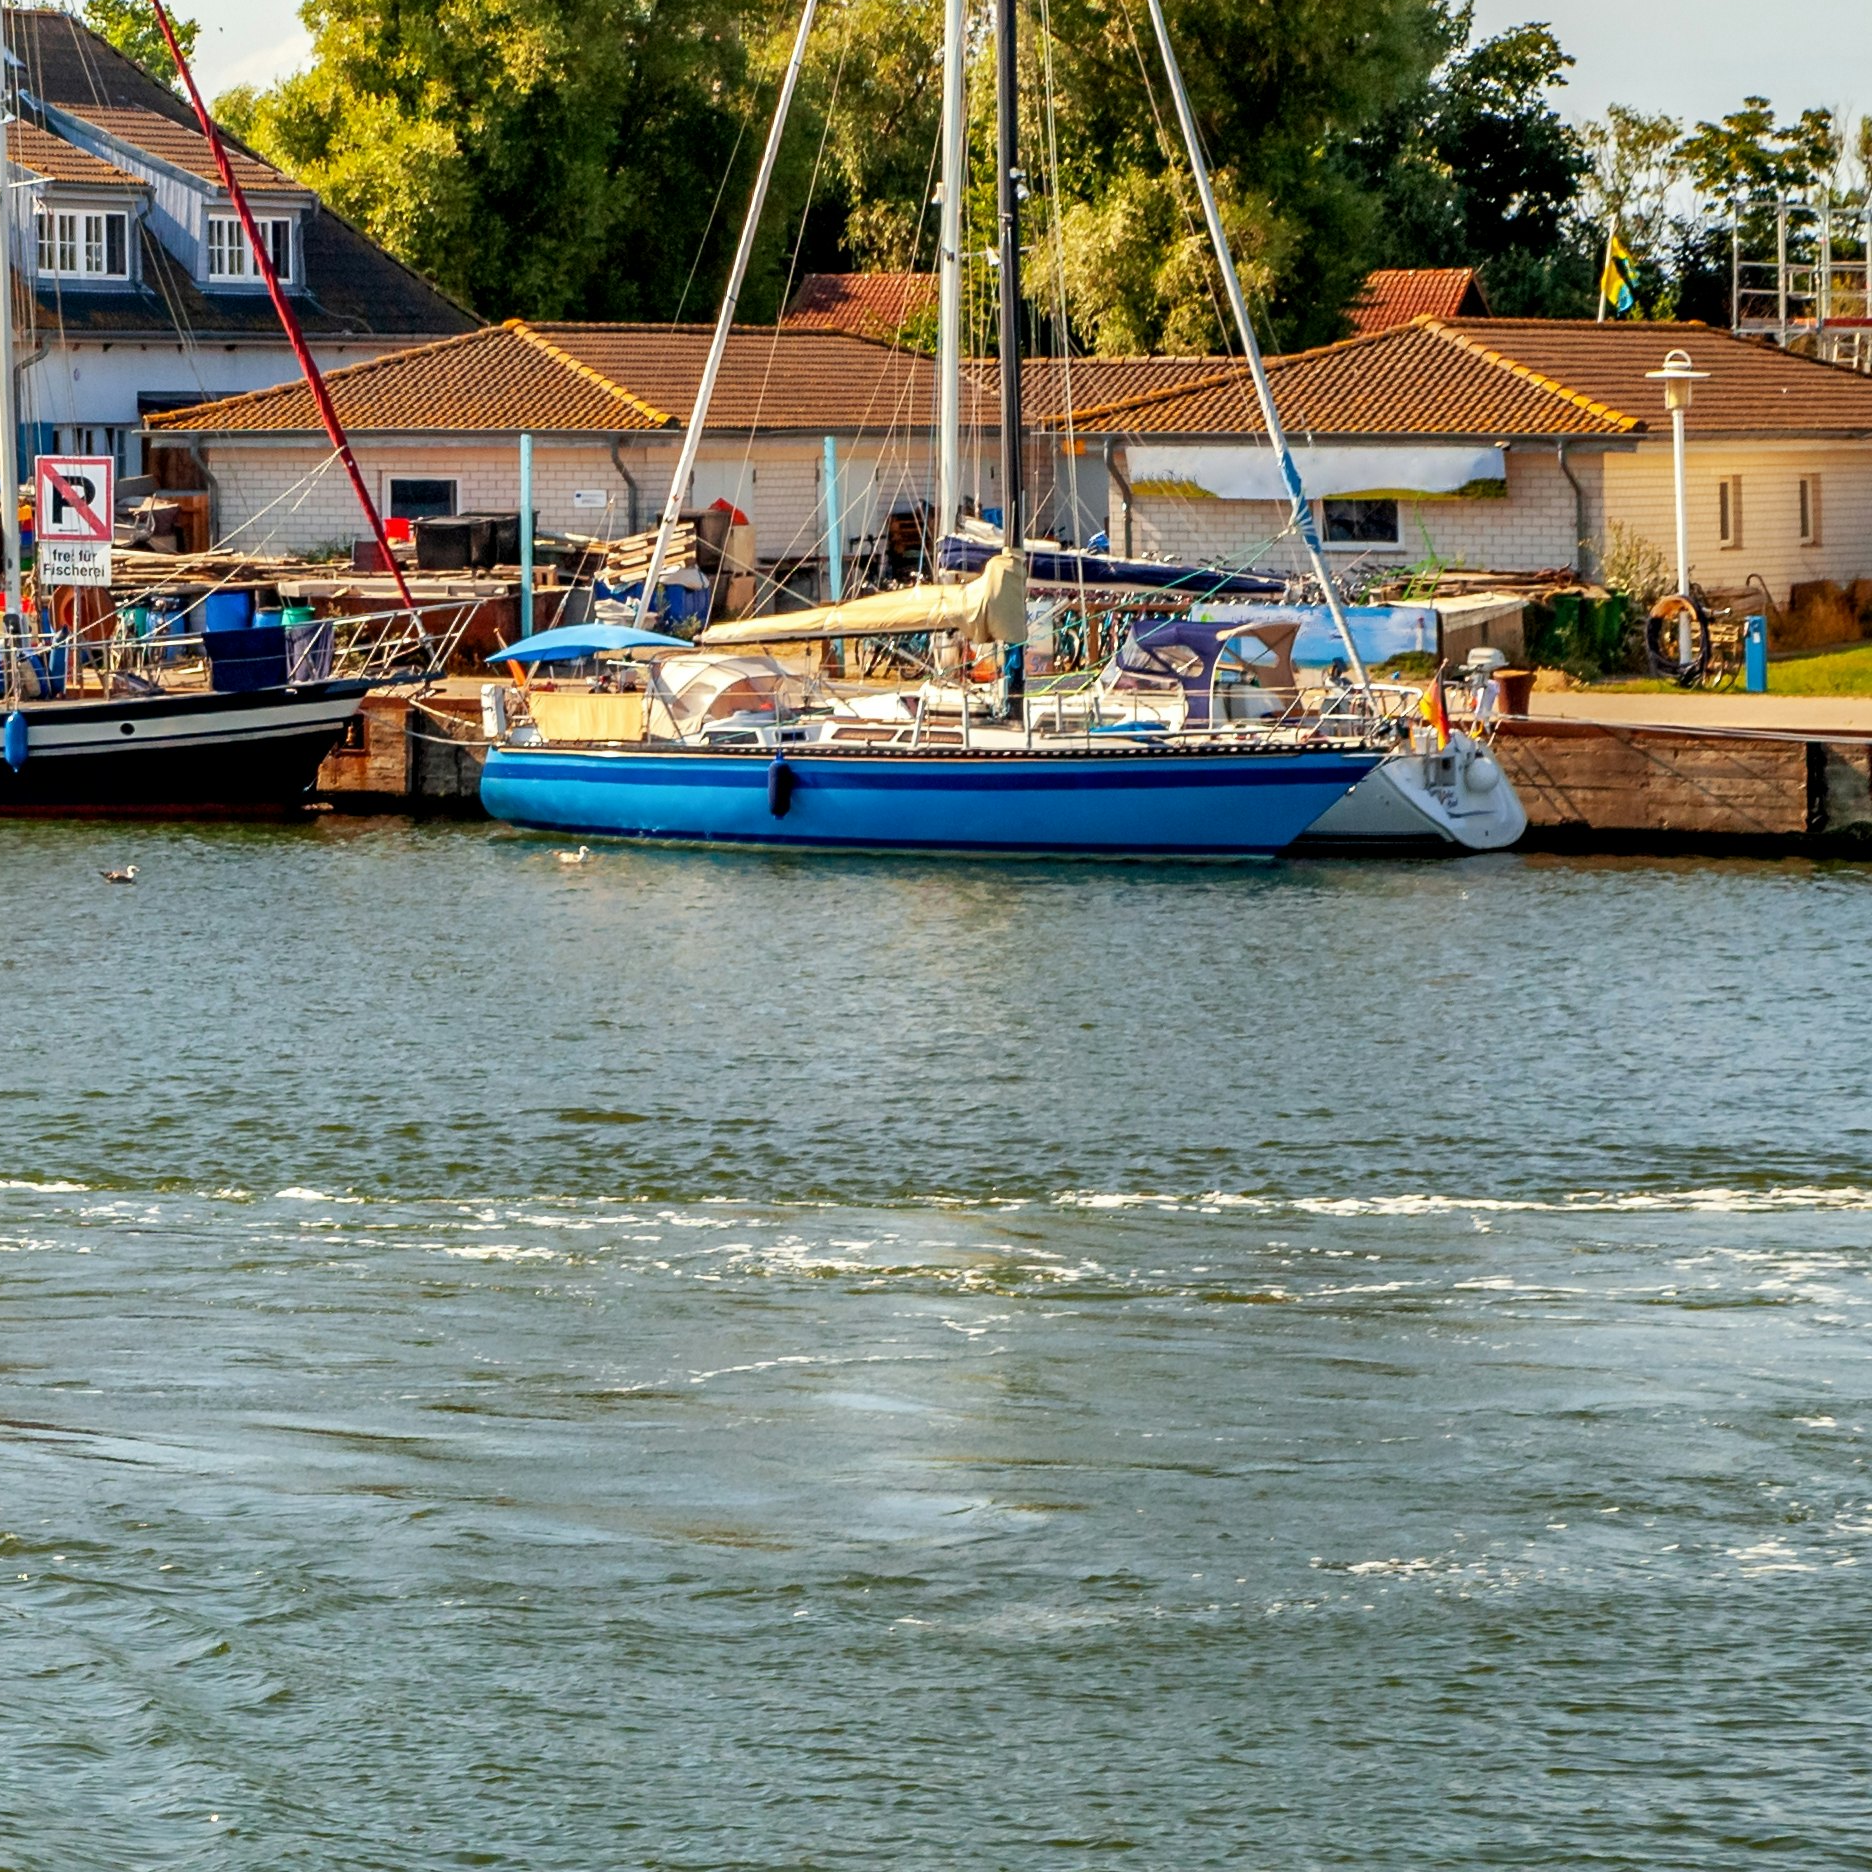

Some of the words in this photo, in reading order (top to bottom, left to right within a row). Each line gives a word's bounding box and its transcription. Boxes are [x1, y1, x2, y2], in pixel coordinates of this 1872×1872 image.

[52, 475, 96, 524] P
[52, 548, 74, 562] frei
[79, 549, 97, 562] für
[43, 563, 105, 577] Fischerei
